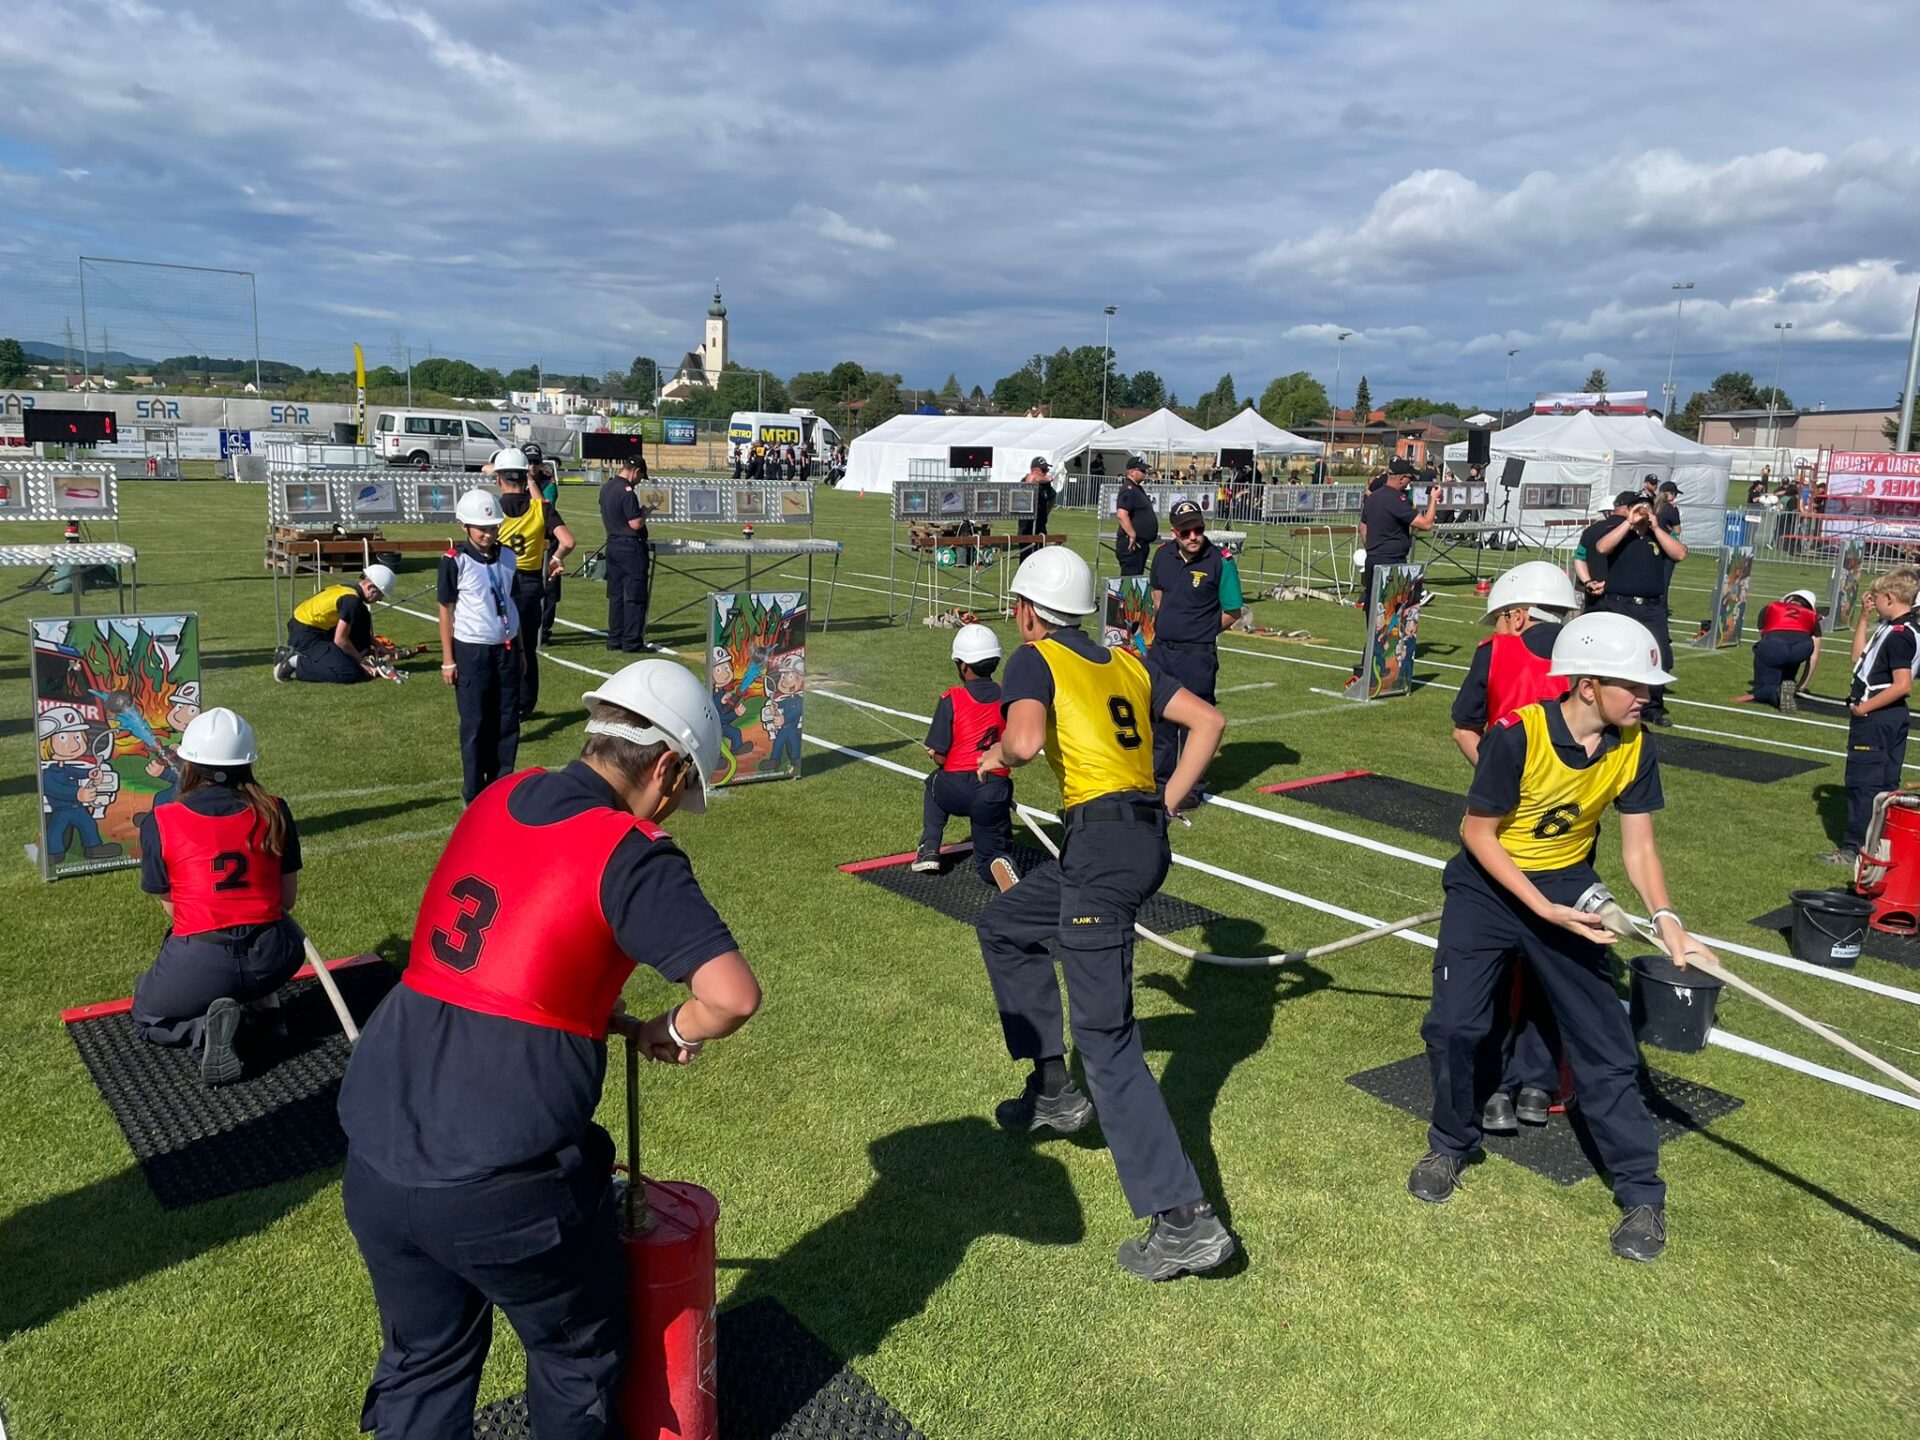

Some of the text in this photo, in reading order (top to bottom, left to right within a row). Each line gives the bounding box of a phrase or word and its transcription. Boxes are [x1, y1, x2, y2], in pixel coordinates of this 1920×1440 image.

[136, 398, 181, 419] SAR
[271, 404, 310, 425] SAR
[729, 428, 752, 439] METRO
[1785, 607, 1802, 619] 2
[1107, 695, 1144, 750] 9
[1532, 802, 1584, 840] 6
[211, 850, 249, 893] 2
[429, 872, 501, 975] 3
[1072, 916, 1092, 924] PLANK
